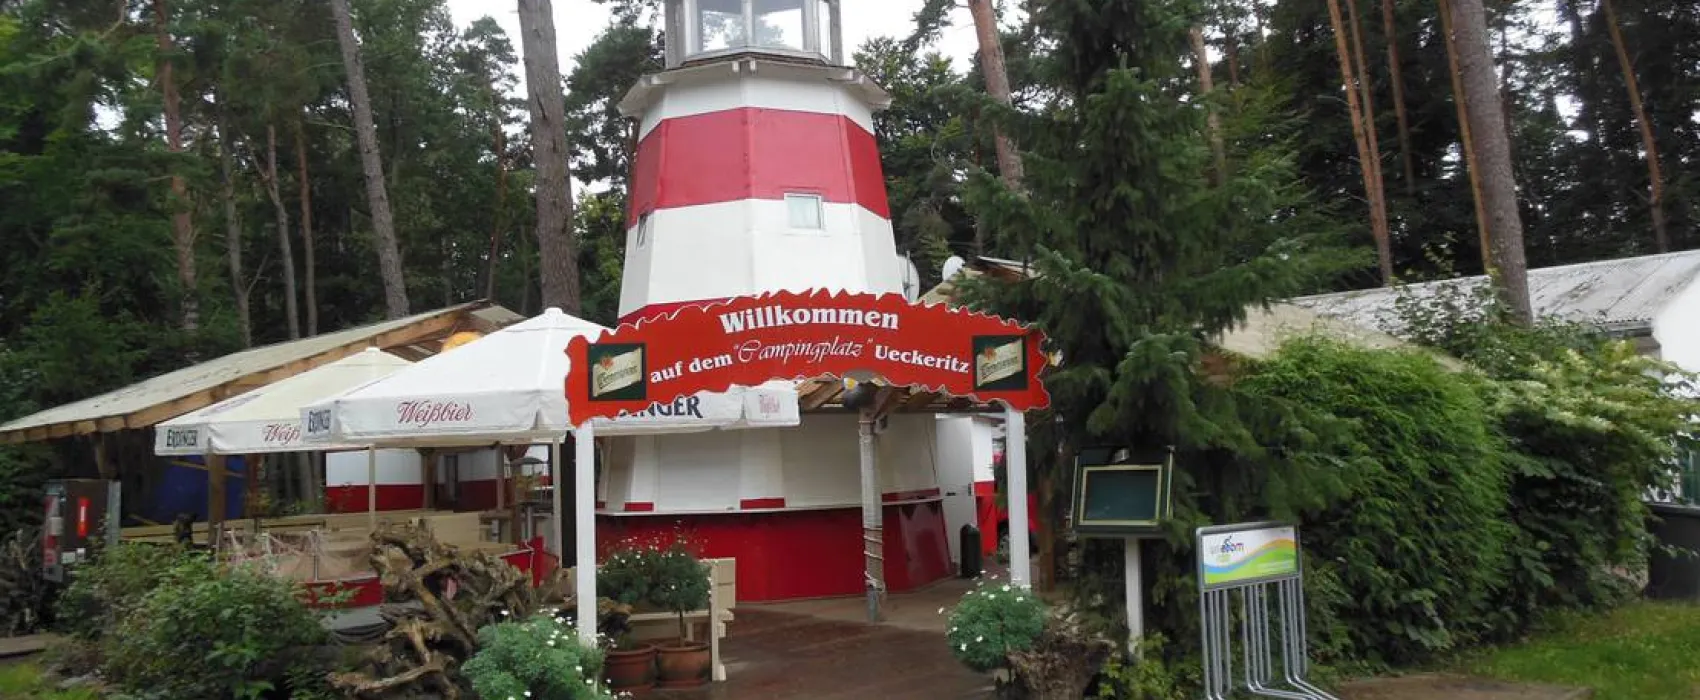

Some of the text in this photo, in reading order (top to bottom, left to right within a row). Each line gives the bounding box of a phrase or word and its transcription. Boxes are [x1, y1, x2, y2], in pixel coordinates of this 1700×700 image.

[718, 305, 900, 333] Willkommen
[650, 361, 683, 384] auf
[688, 353, 734, 373] dem
[875, 345, 970, 373] Ueckeritz
[397, 399, 474, 427] Weißbier
